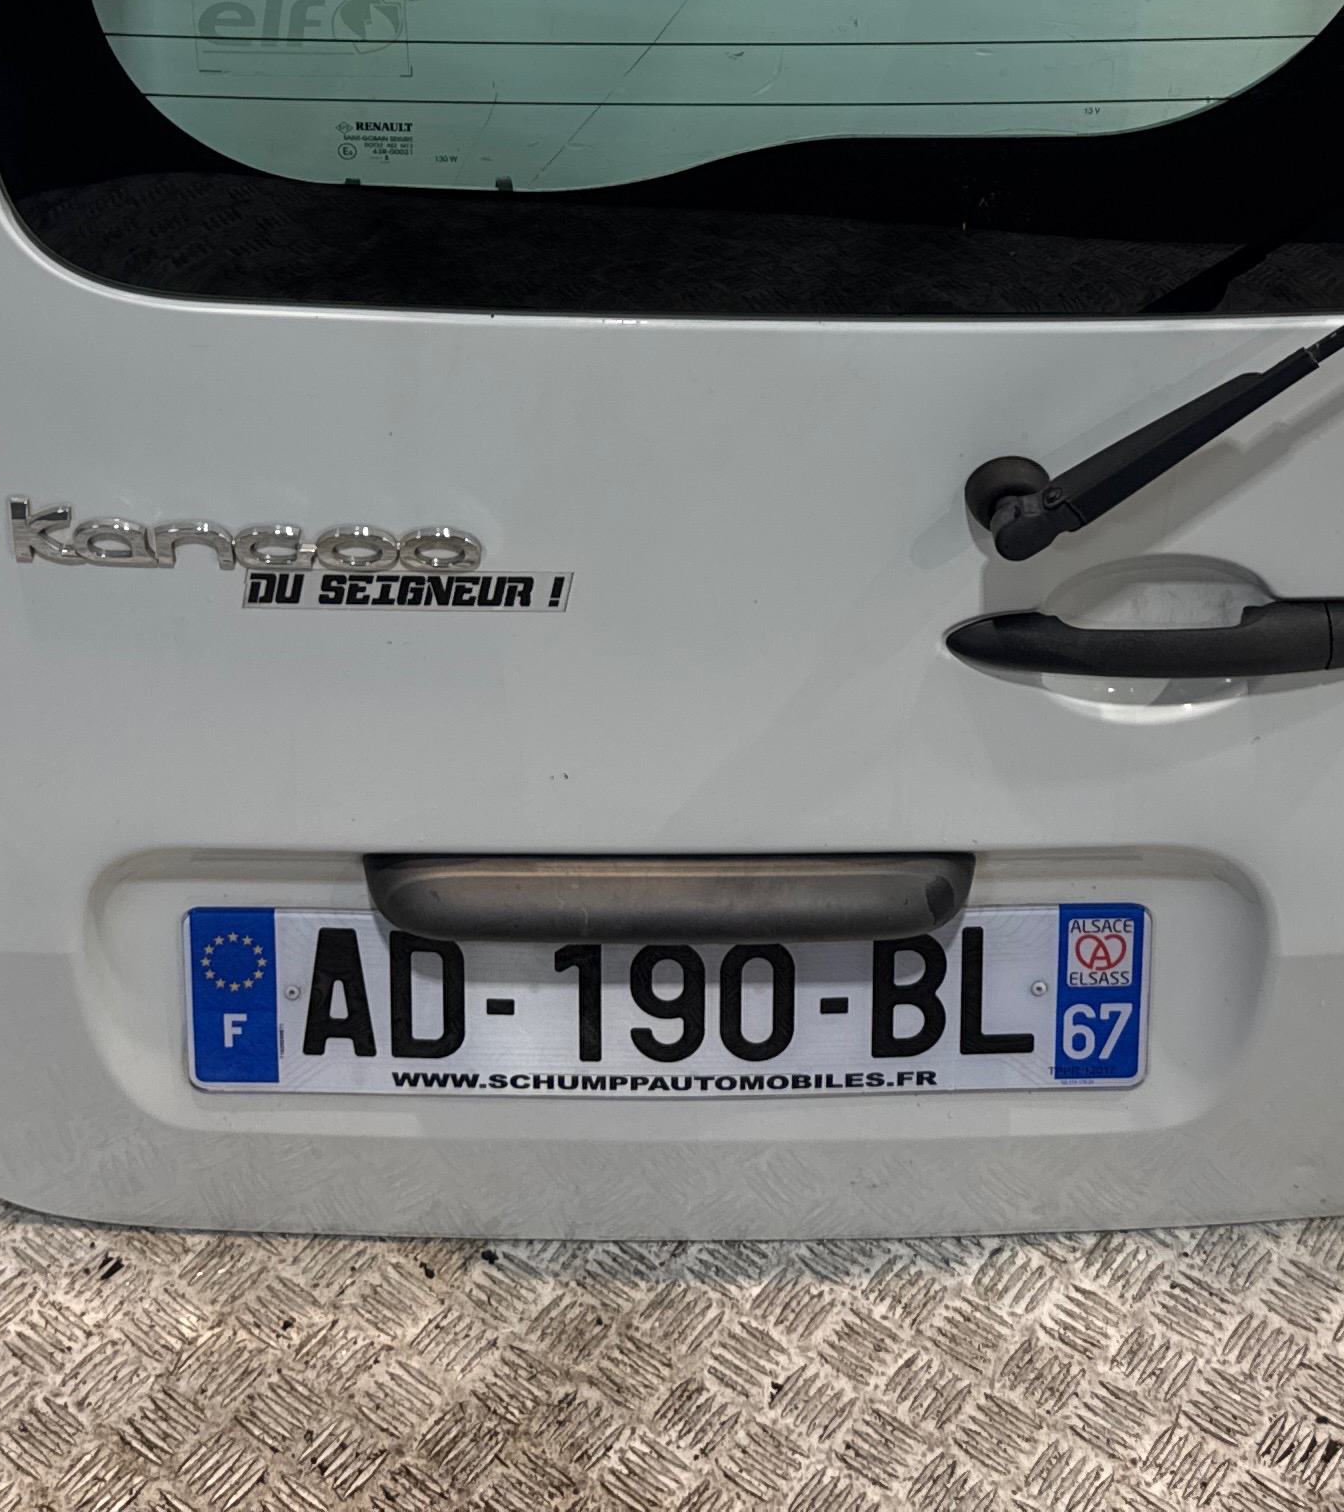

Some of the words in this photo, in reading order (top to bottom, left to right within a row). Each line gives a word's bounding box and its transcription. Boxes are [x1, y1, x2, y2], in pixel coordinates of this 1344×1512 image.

[355, 121, 413, 132] RENAULT
[247, 572, 306, 605] DU
[318, 574, 535, 608] SEIGNEUR
[1070, 919, 1133, 934] ALSACE
[1069, 971, 1130, 986] ELSASS
[223, 1013, 248, 1048] F
[1062, 1002, 1133, 1061] 67
[392, 1071, 938, 1092] WWW.SCHUMPPAUTOMOBILES.FR
